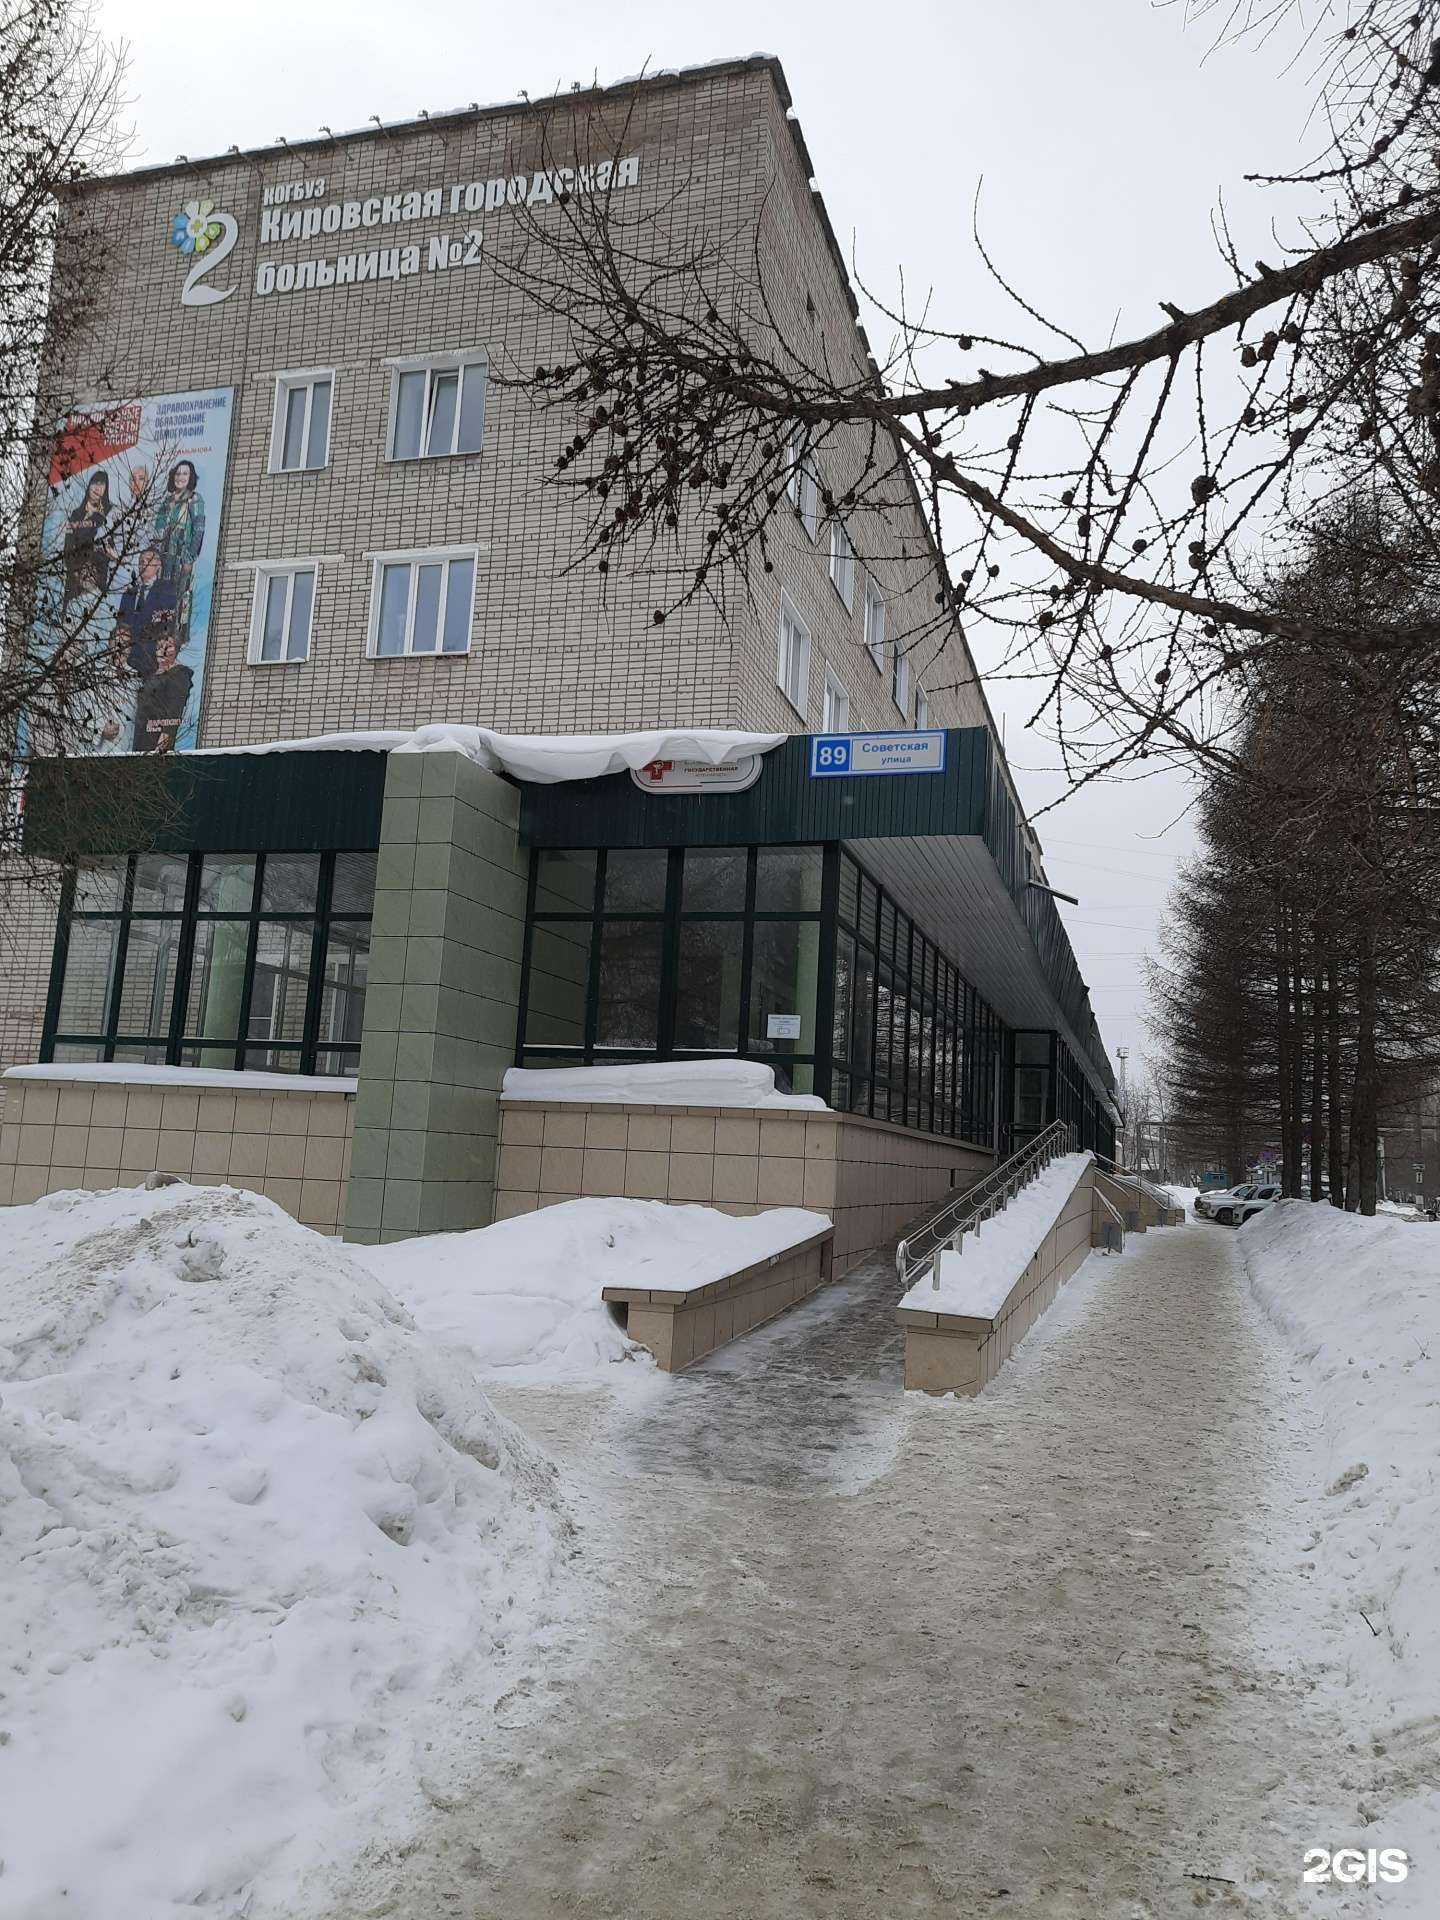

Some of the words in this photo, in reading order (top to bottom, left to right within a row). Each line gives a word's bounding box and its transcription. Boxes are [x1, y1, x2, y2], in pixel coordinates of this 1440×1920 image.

[260, 187, 444, 244] Кировская
[450, 156, 640, 214] городская
[263, 178, 326, 207] КОГБУЗ
[256, 244, 421, 297] больница
[428, 229, 484, 272] №2
[156, 396, 227, 416] ЗДРАВООХРАНЕНИЕ
[154, 411, 206, 429] ОБРАЗОВАНИЕ
[819, 746, 848, 766] 89
[862, 741, 929, 753] Советская
[881, 756, 912, 765] улица
